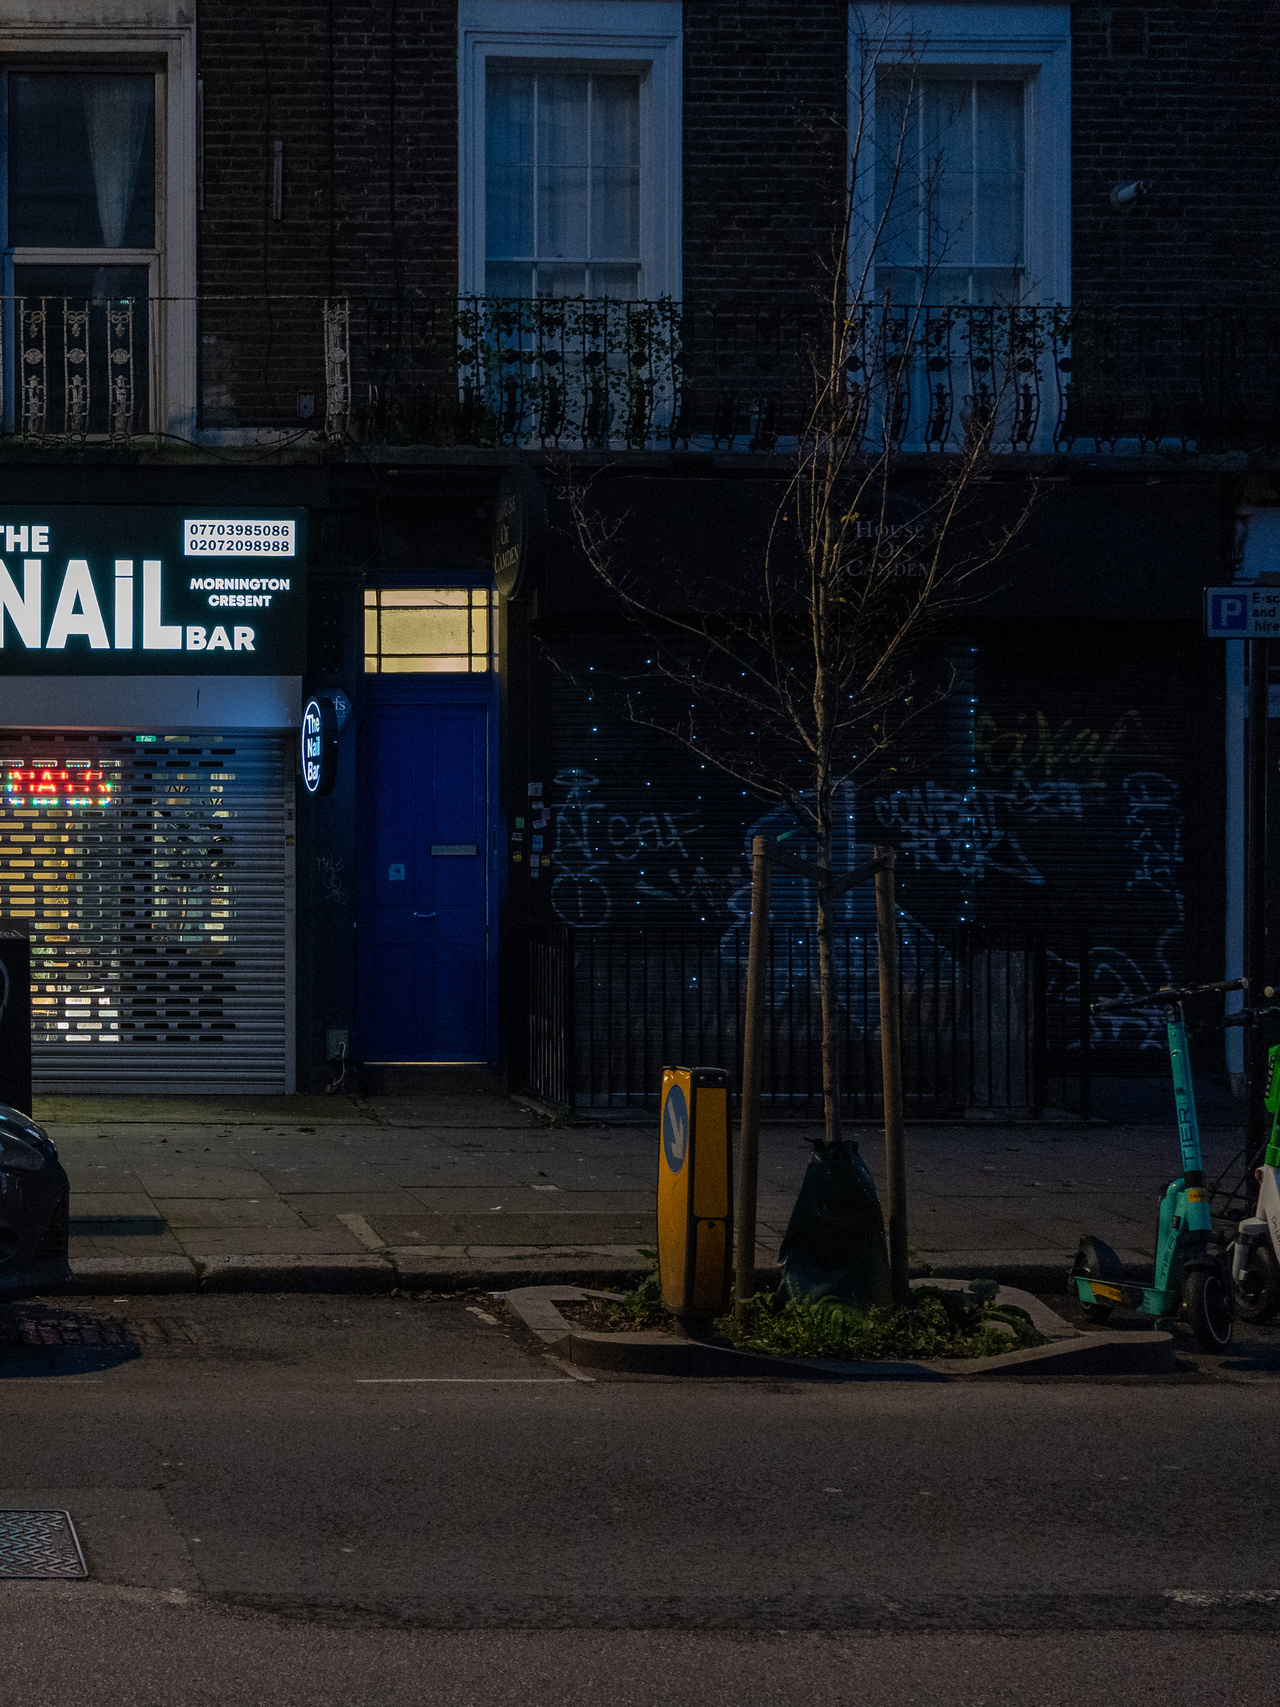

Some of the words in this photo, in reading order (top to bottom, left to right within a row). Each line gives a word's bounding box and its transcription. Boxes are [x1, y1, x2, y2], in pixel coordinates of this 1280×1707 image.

[189, 523, 290, 536] 07703985086
[189, 539, 290, 552] 02072098988
[189, 577, 291, 591] MORNINGTON
[208, 594, 272, 607] CRESENT
[1252, 606, 1276, 617] and
[1255, 620, 1280, 631] hire
[186, 626, 256, 651] BAR
[306, 713, 320, 735] The
[307, 735, 320, 758] Nail
[307, 761, 320, 781] Bar
[1178, 1107, 1195, 1168] TIER
